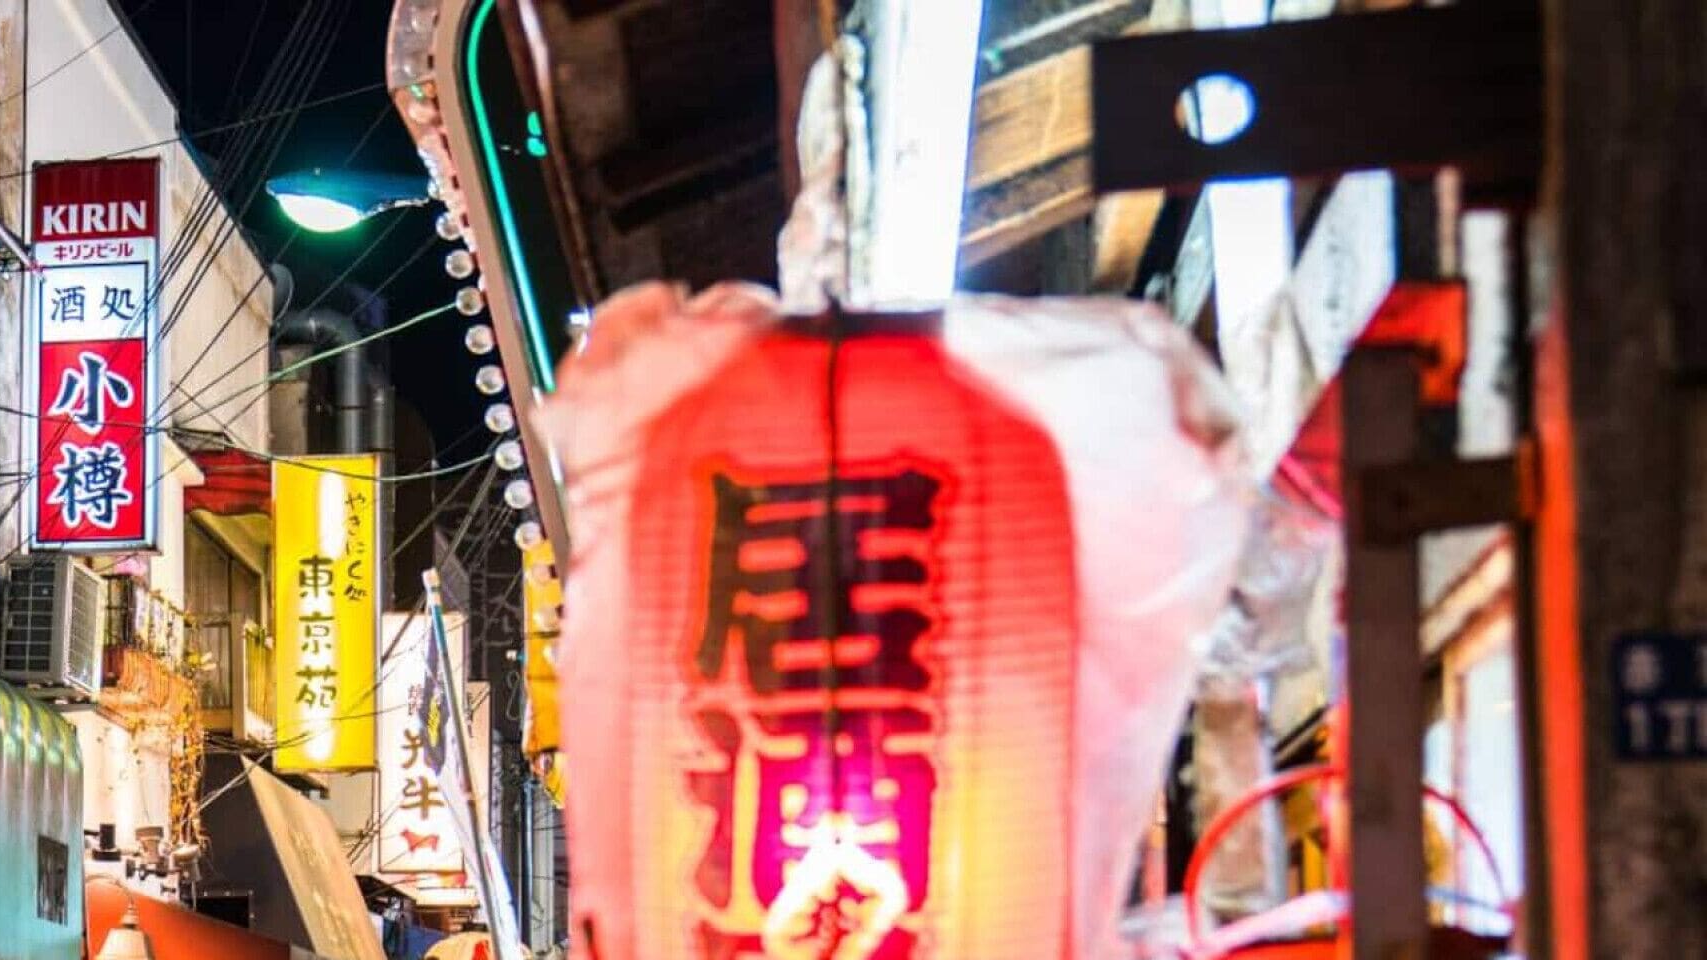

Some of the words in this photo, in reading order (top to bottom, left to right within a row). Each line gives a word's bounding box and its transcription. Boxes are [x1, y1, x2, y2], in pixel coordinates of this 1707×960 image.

[42, 200, 147, 237] KIRIN
[53, 242, 133, 260] キリンビール
[50, 285, 136, 322] 酒処
[48, 352, 133, 529] 小樽
[344, 491, 368, 602] やきにく処
[296, 556, 338, 709] 東京苑
